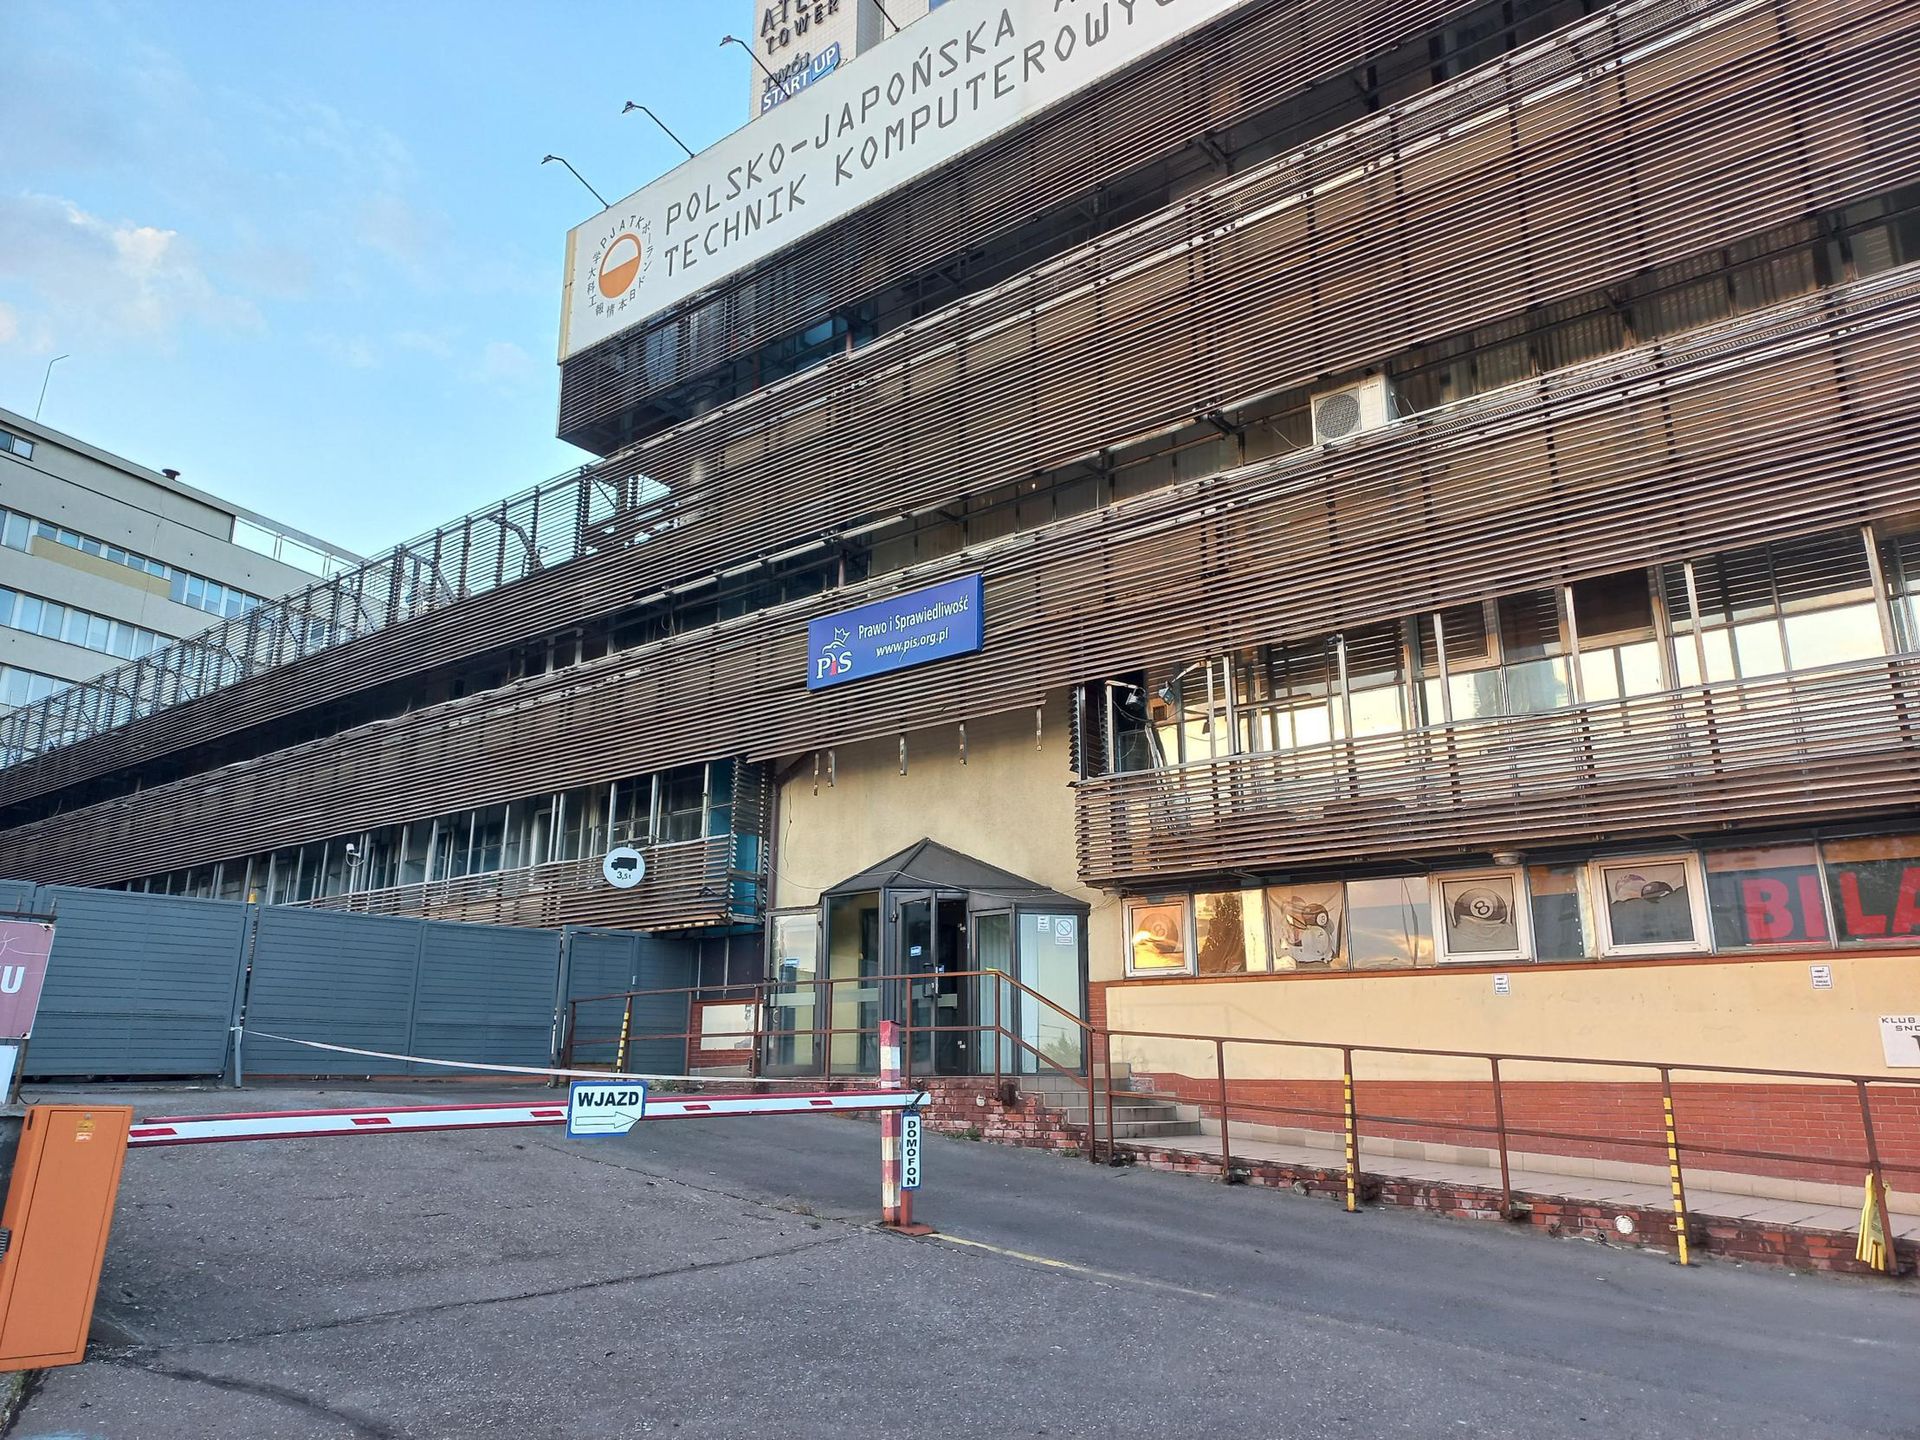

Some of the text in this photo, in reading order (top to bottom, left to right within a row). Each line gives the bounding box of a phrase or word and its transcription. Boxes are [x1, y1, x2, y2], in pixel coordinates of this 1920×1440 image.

[760, 0, 820, 37] ATL
[766, 0, 838, 55] TOWER
[762, 46, 837, 111] START UP
[664, 0, 1175, 277] TECHNIK KOMPUTEROWY
[665, 8, 1016, 236] POLSKO-JAPOŃSKA
[600, 215, 645, 249] PJATK
[858, 594, 969, 640] Prawo i Sprawiedliwość
[875, 627, 949, 658] www.pis.org.pl
[0, 965, 25, 994] U
[578, 1091, 639, 1107] WJAZD
[906, 1120, 917, 1186] DOMOFON
